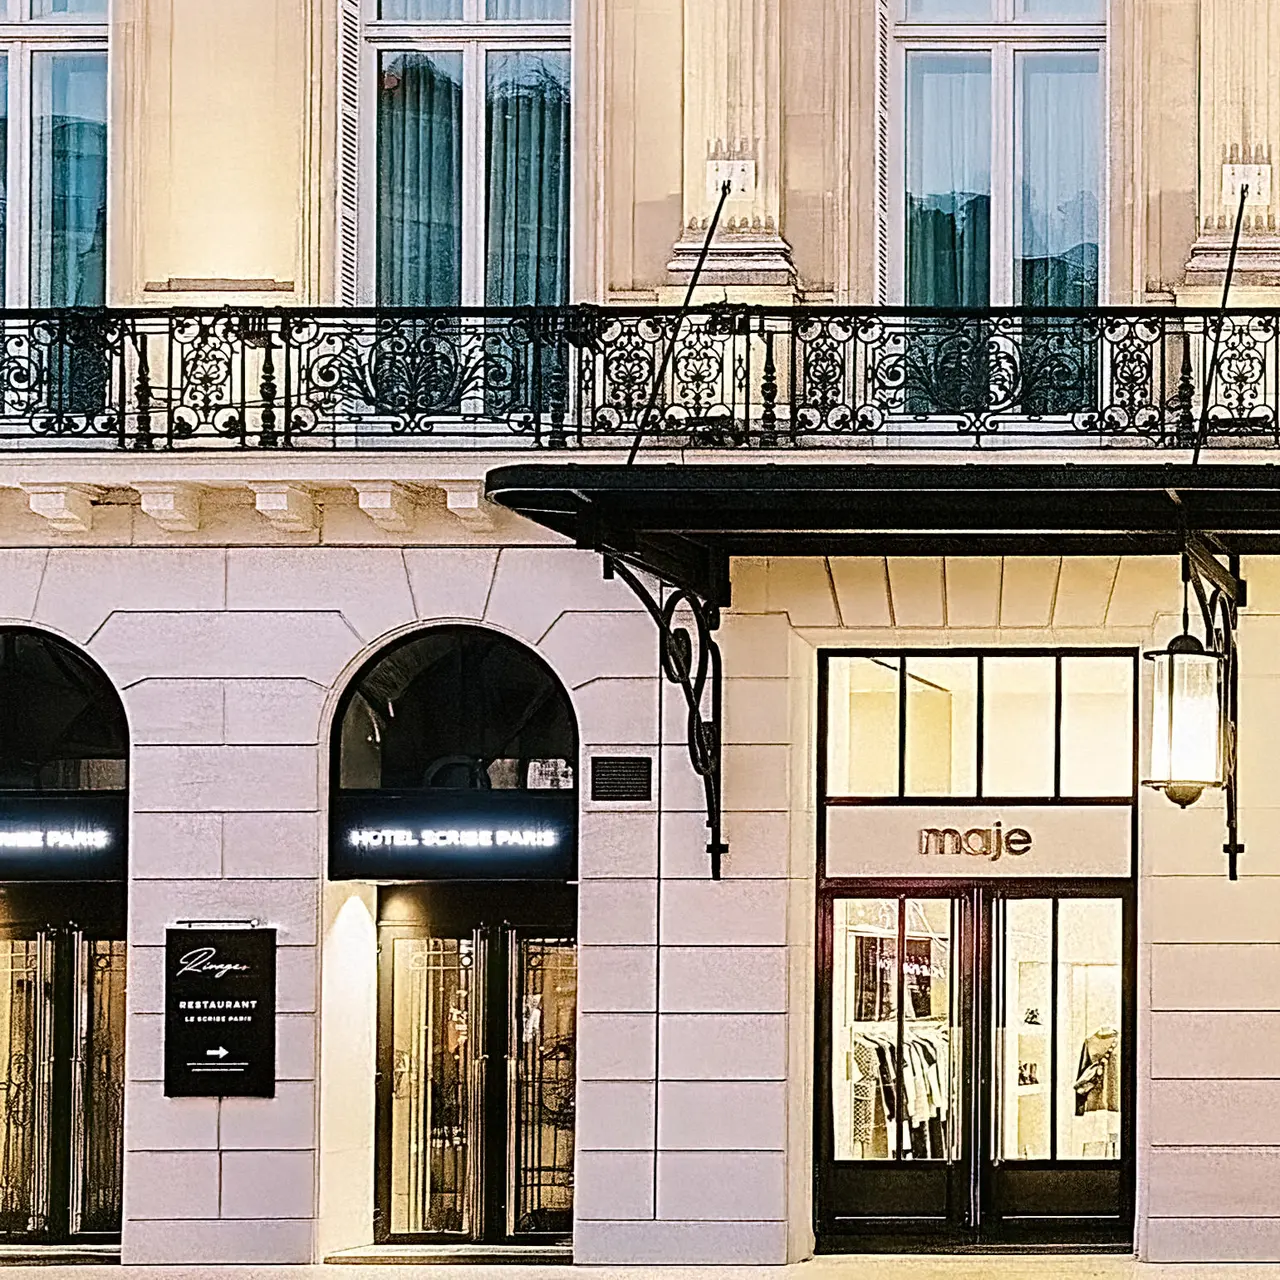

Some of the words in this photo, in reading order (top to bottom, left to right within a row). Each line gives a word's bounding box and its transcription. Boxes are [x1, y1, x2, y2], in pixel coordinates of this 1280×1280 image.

[350, 829, 418, 846] HOTEL
[421, 829, 493, 847] SCRIBE
[495, 829, 557, 847] PARIS
[918, 820, 1033, 862] maje
[179, 1000, 258, 1010] RESTAURANT
[184, 1015, 196, 1023] LE
[197, 1015, 226, 1023] SCRIBE
